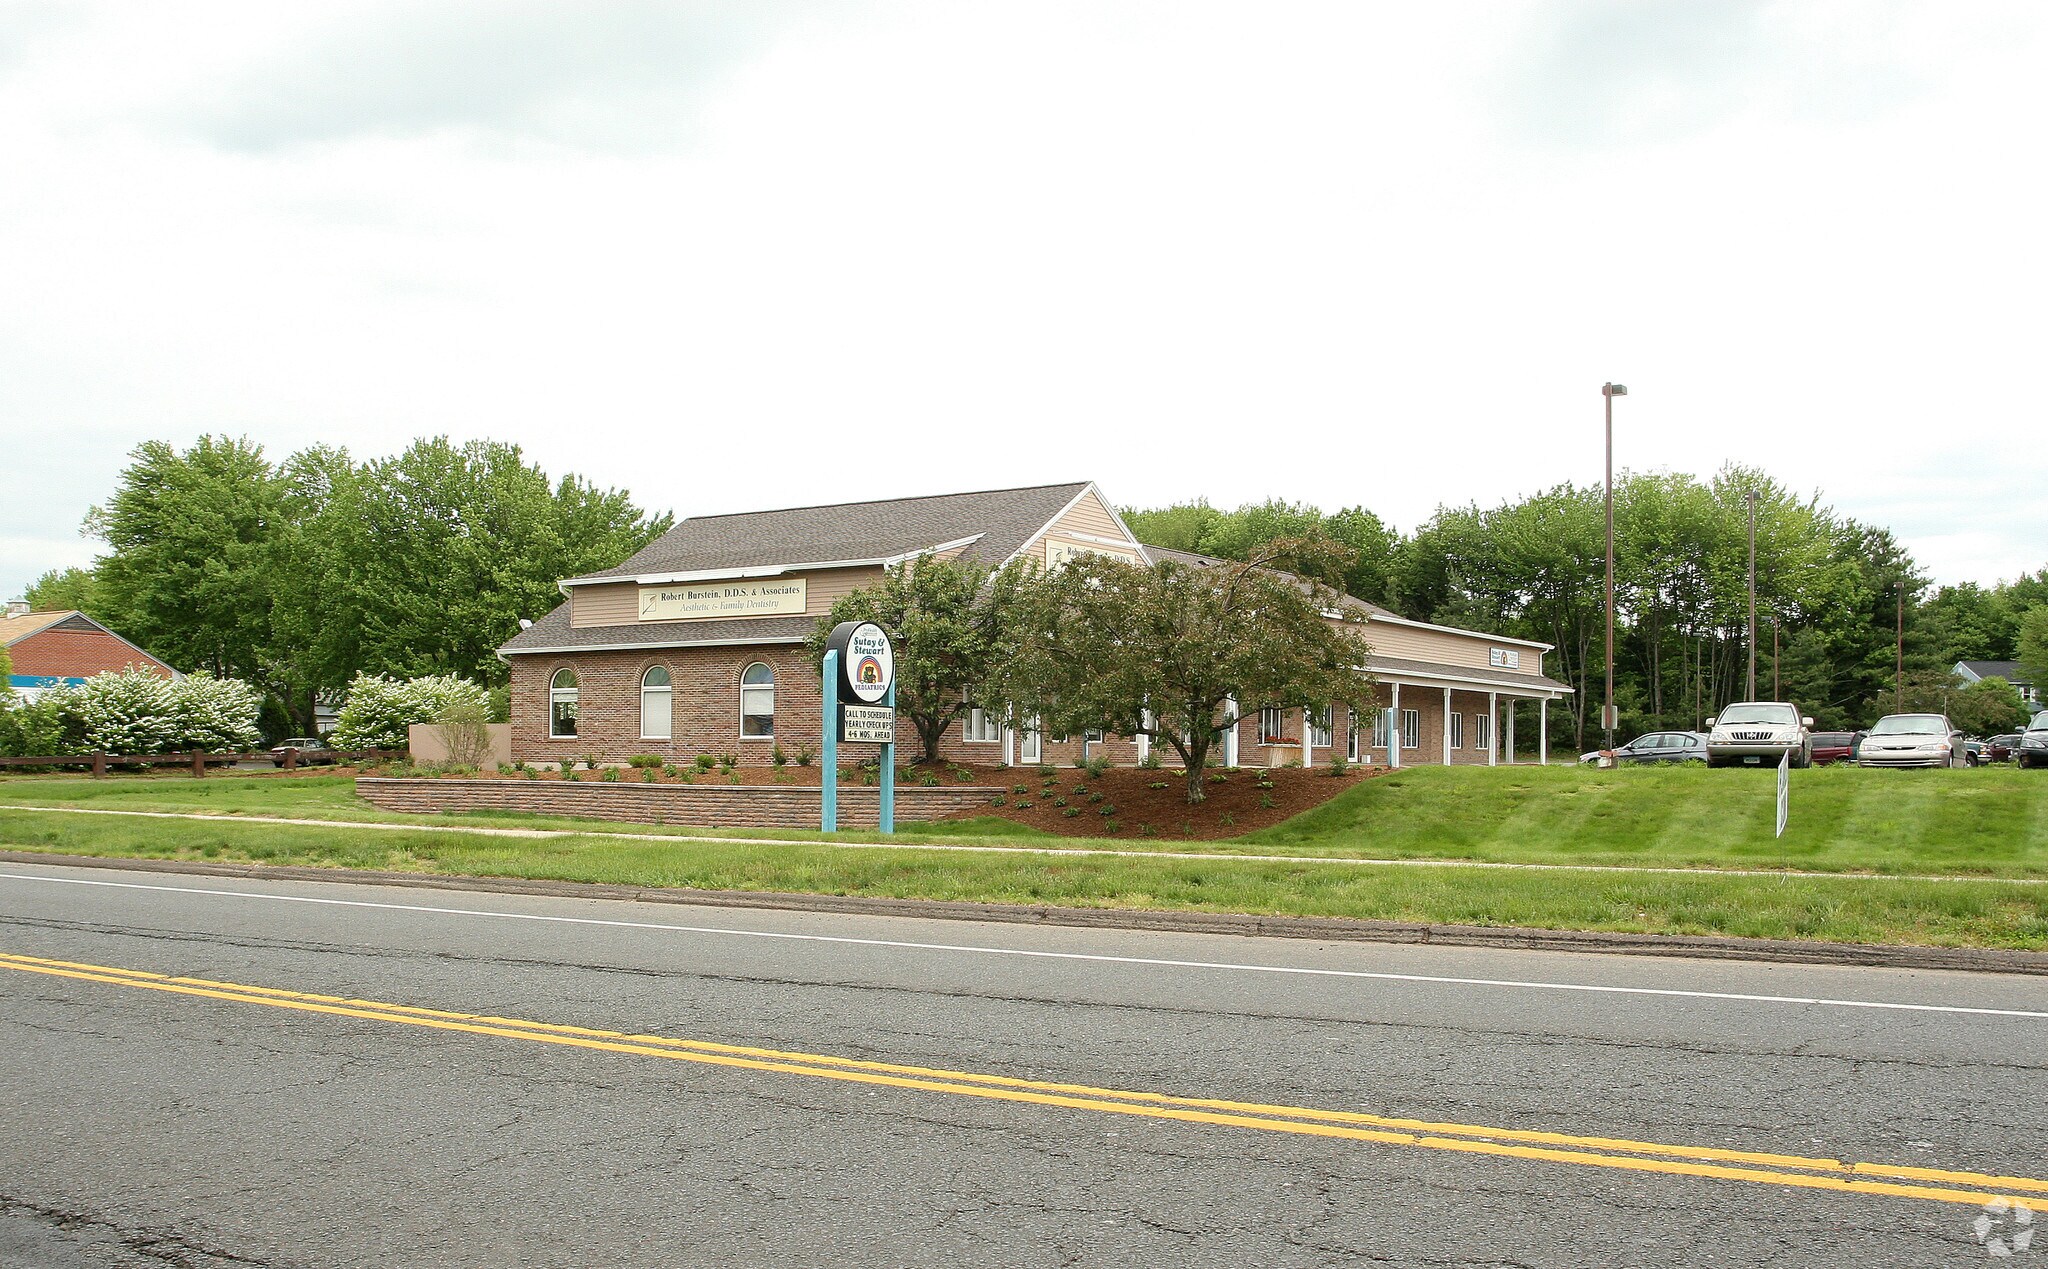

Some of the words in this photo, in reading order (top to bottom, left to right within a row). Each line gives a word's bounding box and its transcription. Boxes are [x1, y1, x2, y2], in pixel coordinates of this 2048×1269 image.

[661, 592, 684, 601] Robert
[724, 587, 748, 597] D.D.S.
[751, 588, 757, 596] &
[760, 585, 800, 595] Associates
[680, 602, 709, 612] Aesthetic
[712, 602, 719, 610] &
[720, 600, 745, 611] Family
[746, 599, 779, 609] Dentistry
[854, 637, 876, 648] Sutay
[878, 638, 885, 646] &
[854, 646, 884, 655] Stewart
[846, 710, 858, 718] CALL
[860, 710, 867, 718] TO
[867, 711, 891, 719] SCHEDULE
[845, 720, 866, 728] YEARLY
[882, 721, 892, 729] UPS
[848, 730, 857, 738] 4-6
[874, 731, 890, 739] AHEAD
